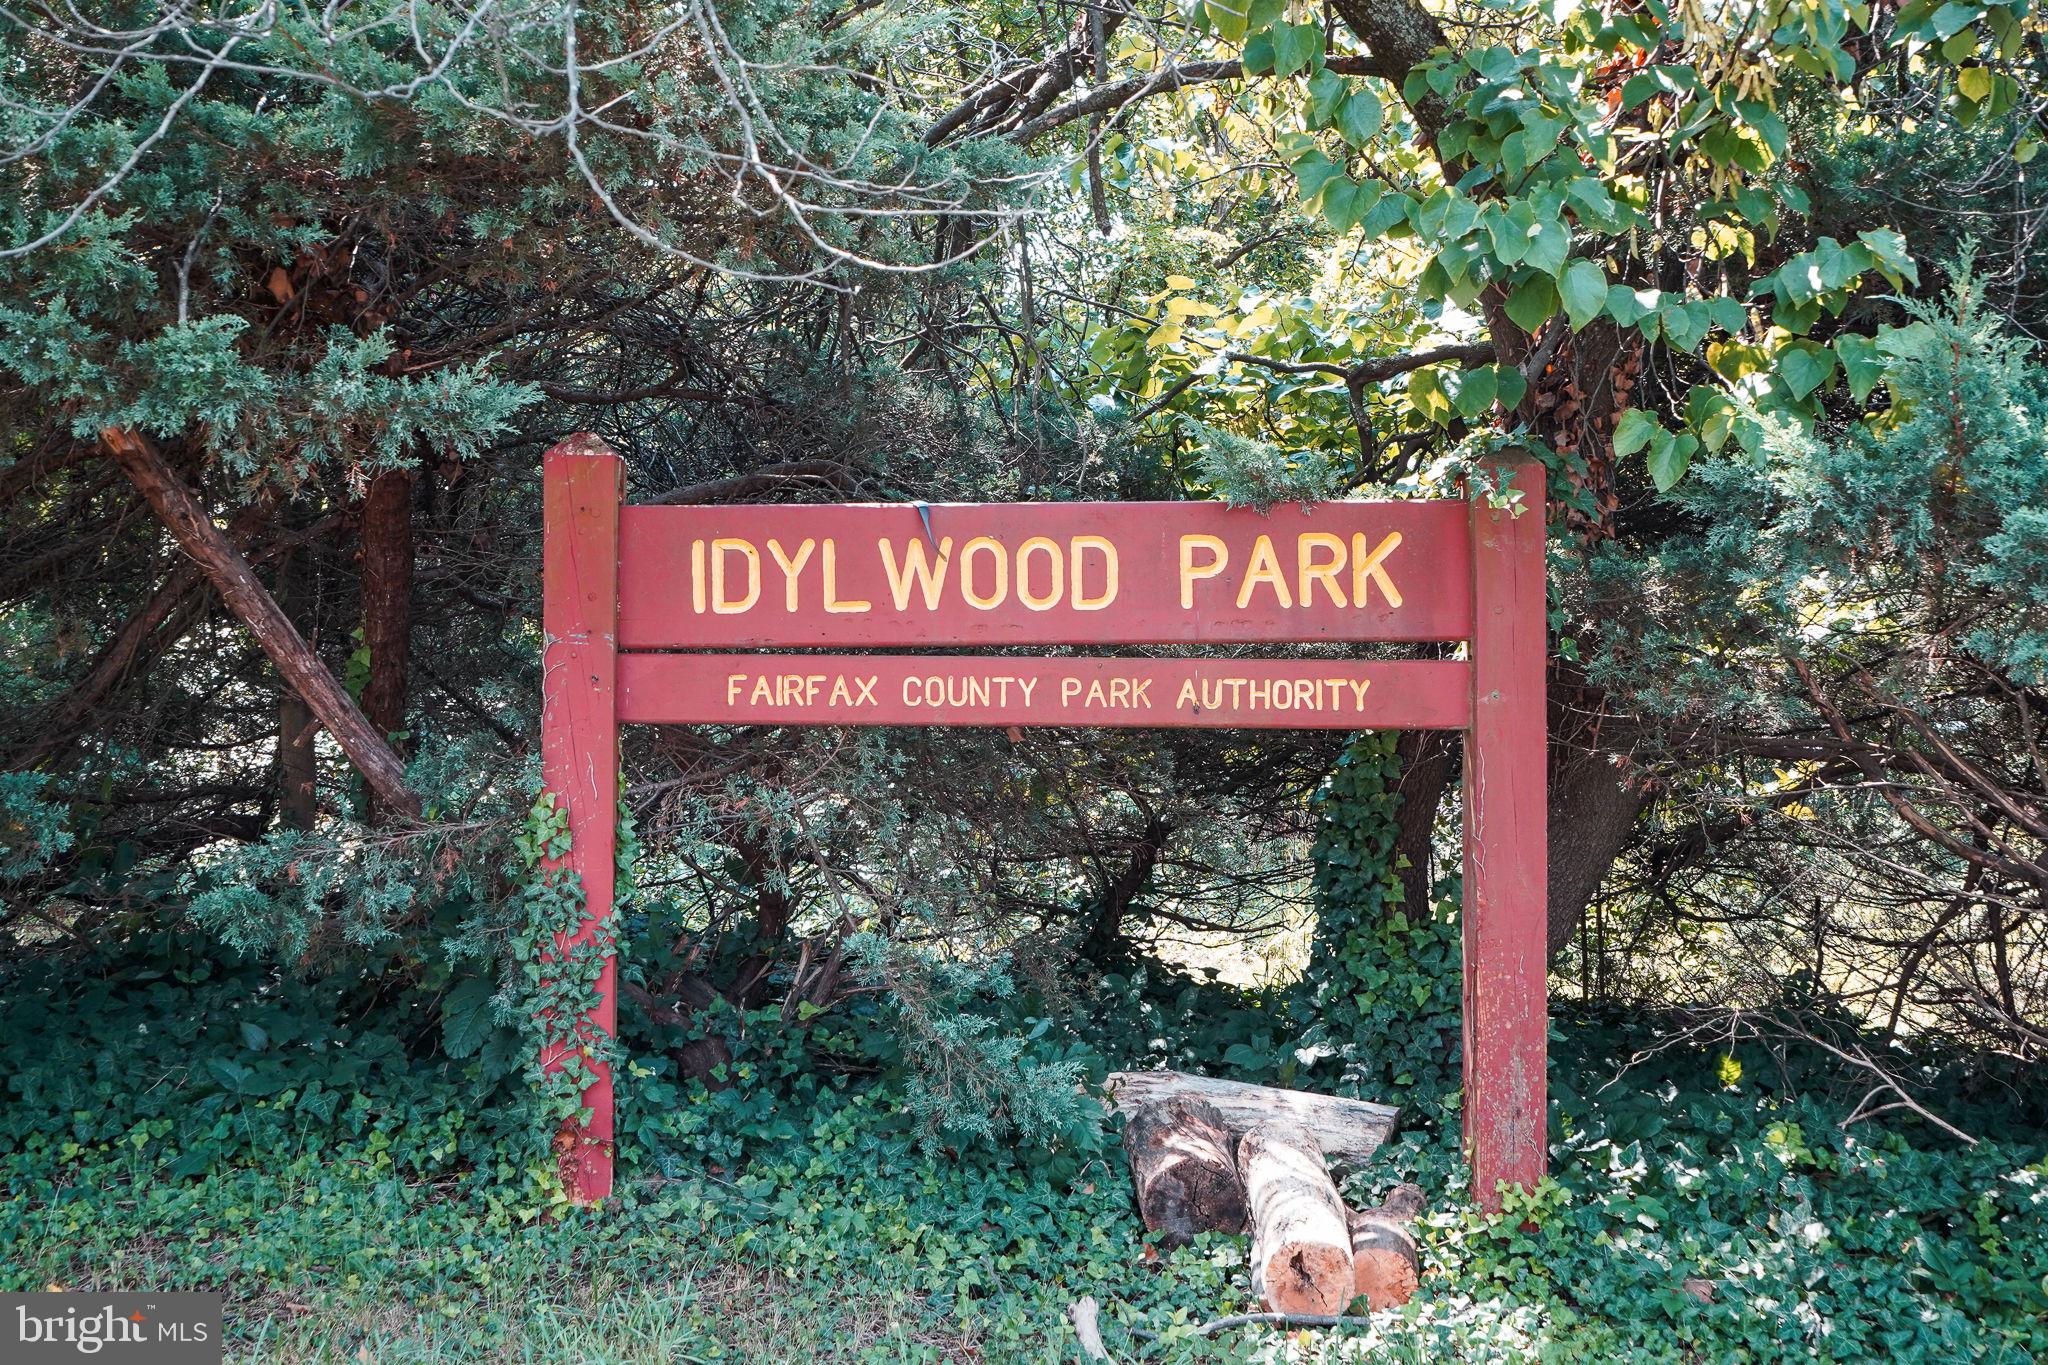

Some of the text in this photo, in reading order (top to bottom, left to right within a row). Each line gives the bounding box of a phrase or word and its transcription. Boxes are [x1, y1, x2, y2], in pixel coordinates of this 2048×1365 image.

[690, 531, 1404, 615] IDYLWOOD PARK
[726, 673, 1372, 713] FAIRFAX COUNTY PARK AUTHORITY
